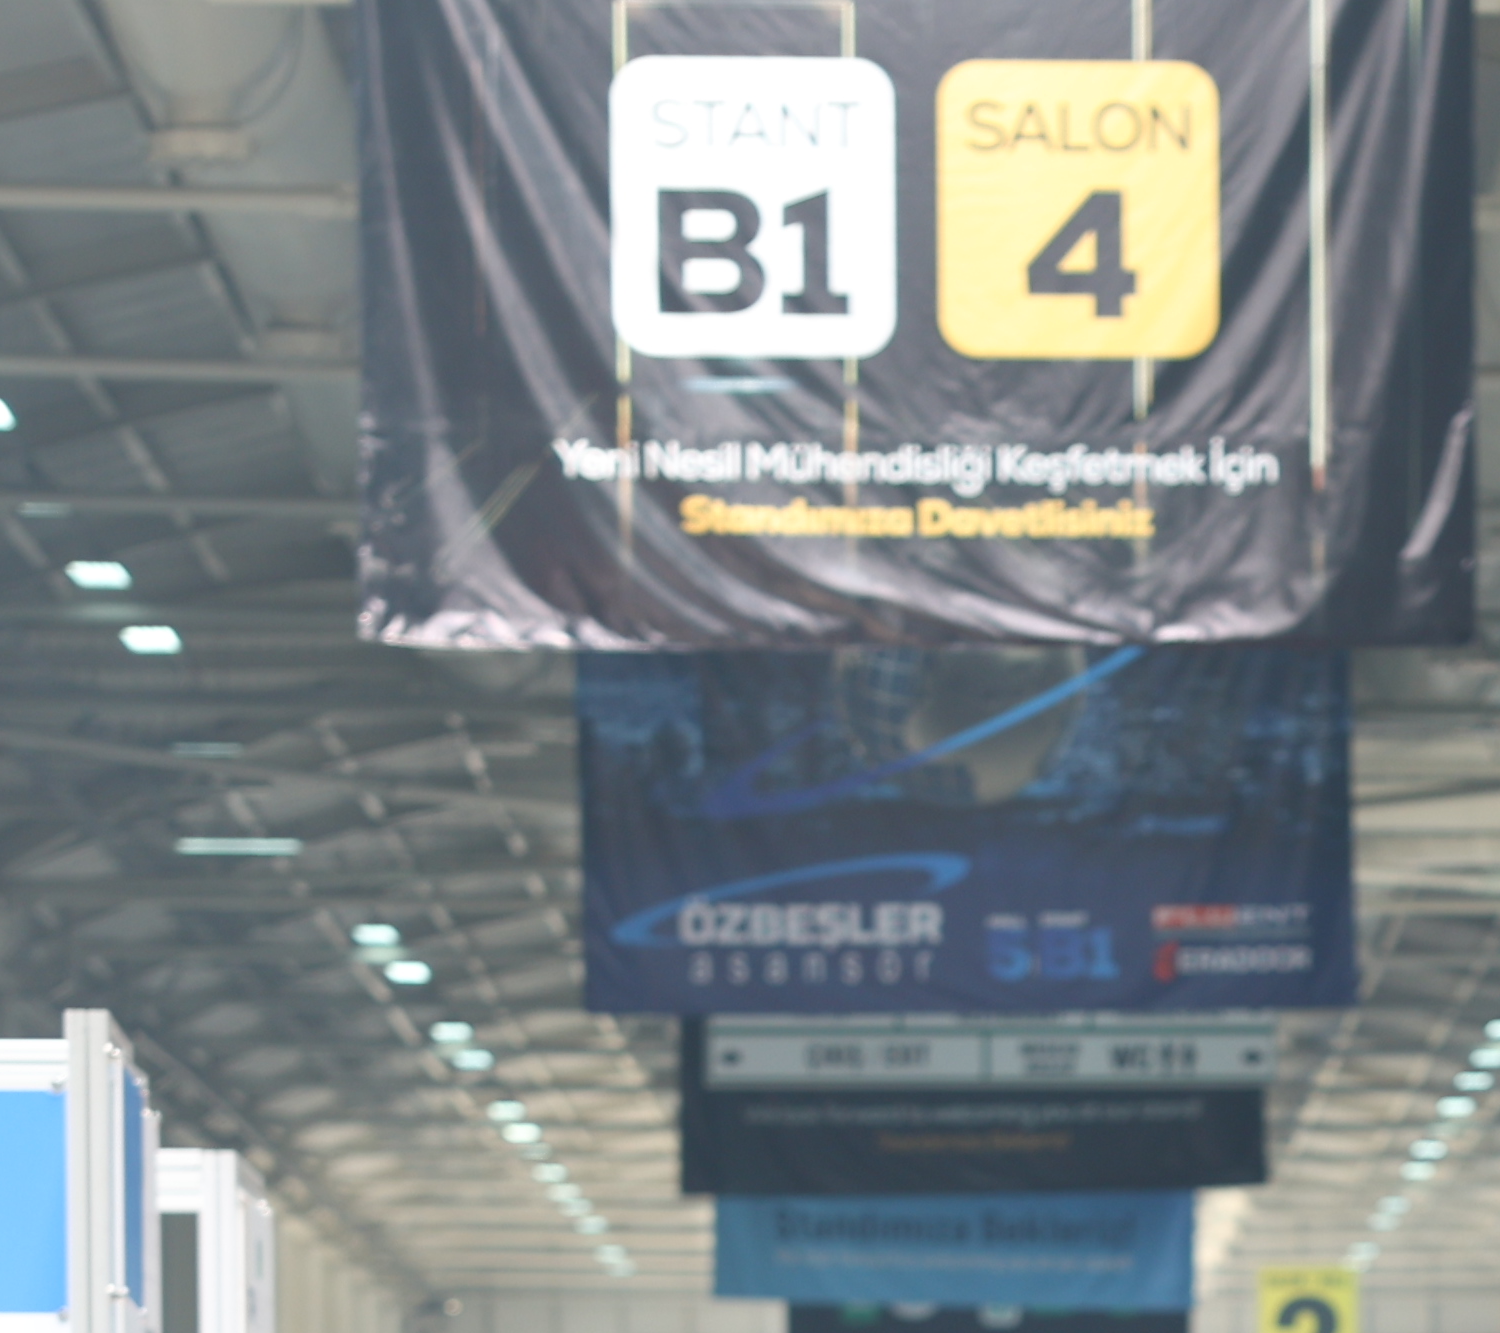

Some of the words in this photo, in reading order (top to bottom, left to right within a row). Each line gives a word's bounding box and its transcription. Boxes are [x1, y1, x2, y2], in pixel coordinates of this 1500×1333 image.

[650, 99, 862, 150] STANT
[964, 100, 1192, 153] SALON
[656, 189, 851, 316] B1
[1024, 189, 1138, 318] 4
[553, 438, 637, 482] Yeni
[644, 438, 739, 482] Nesil
[745, 438, 994, 496] Mühendisliği
[1000, 440, 1204, 493] Keşfetmek
[1209, 436, 1279, 493] İçin
[679, 901, 943, 951] ÖZBEŞLER
